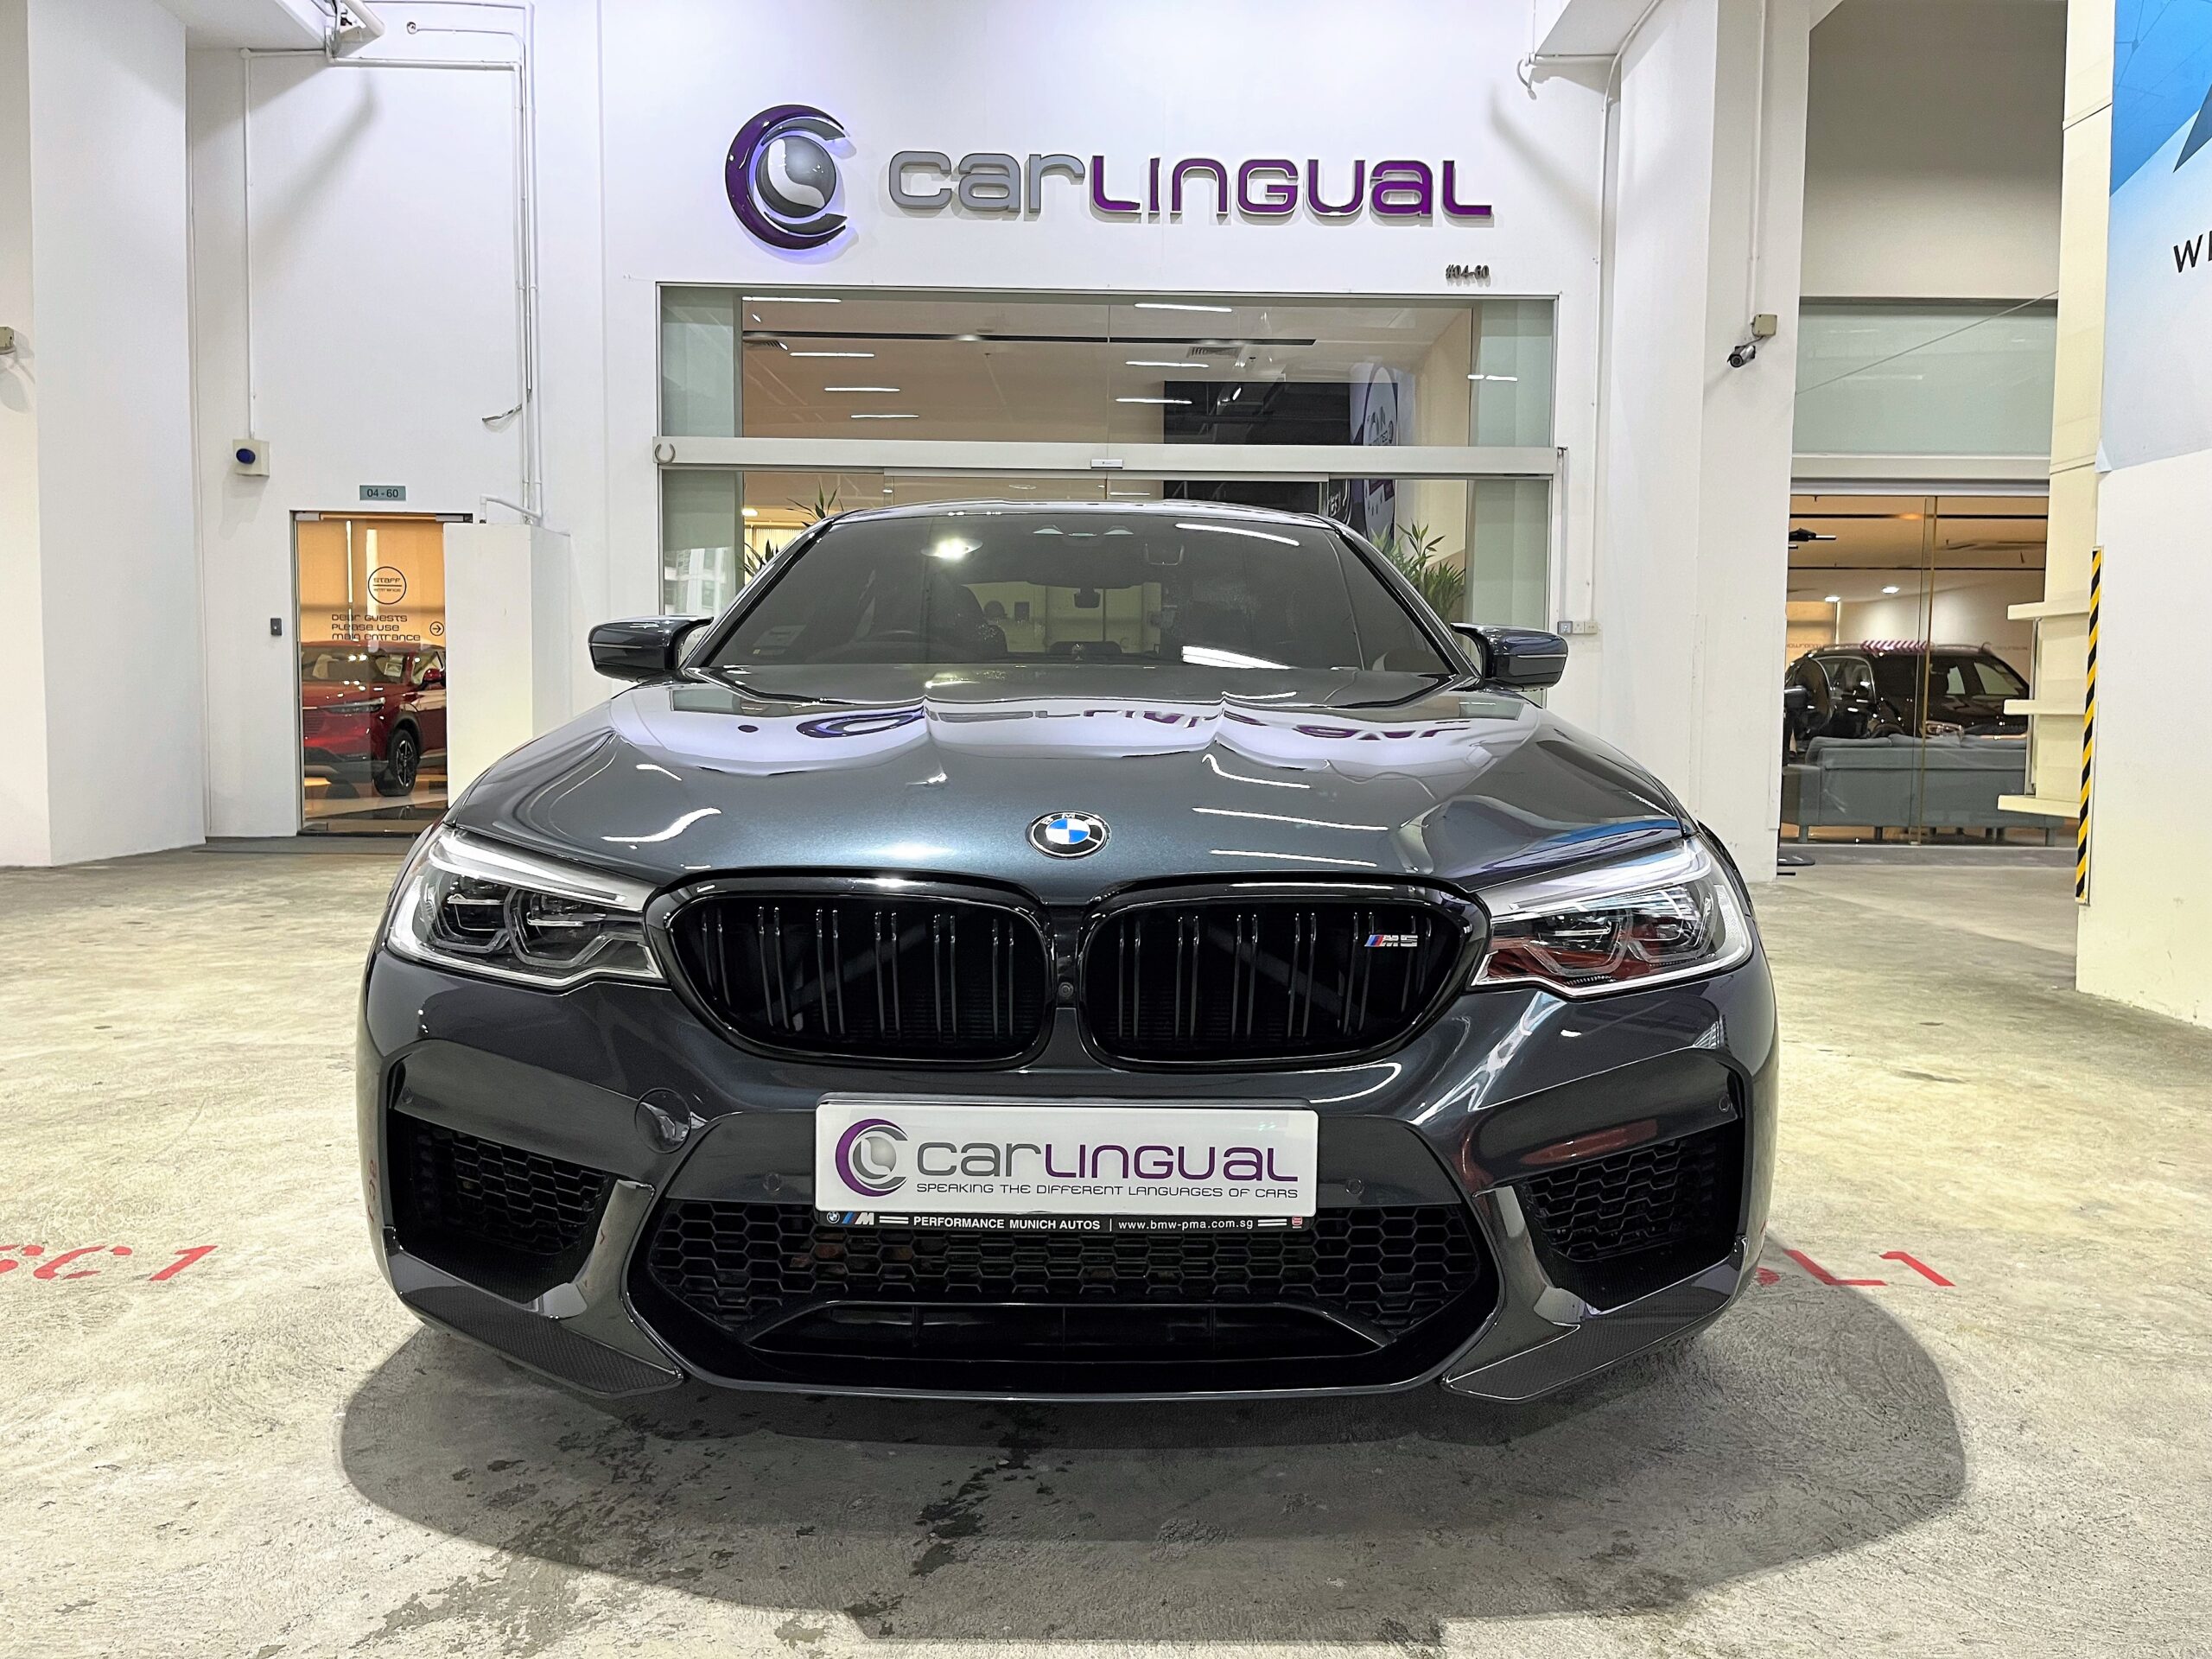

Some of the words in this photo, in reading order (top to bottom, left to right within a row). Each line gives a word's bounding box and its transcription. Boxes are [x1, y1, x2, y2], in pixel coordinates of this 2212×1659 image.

[1446, 264, 1490, 280] #04-60
[1382, 934, 1419, 947] M5
[916, 1183, 994, 1194] SPEAKING
[1000, 1184, 1031, 1194] THE
[1036, 1185, 1123, 1196] DIFFERENT
[1128, 1185, 1224, 1198] LANGUAGES
[1228, 1188, 1250, 1198] OF
[1255, 1188, 1299, 1198] CARS
[913, 1216, 1005, 1229] PERFORMANCE
[1009, 1219, 1057, 1230] MUNICH
[1058, 1220, 1101, 1230] AUTOS
[1118, 1219, 1254, 1231] www.bmw-pma.com.sg
